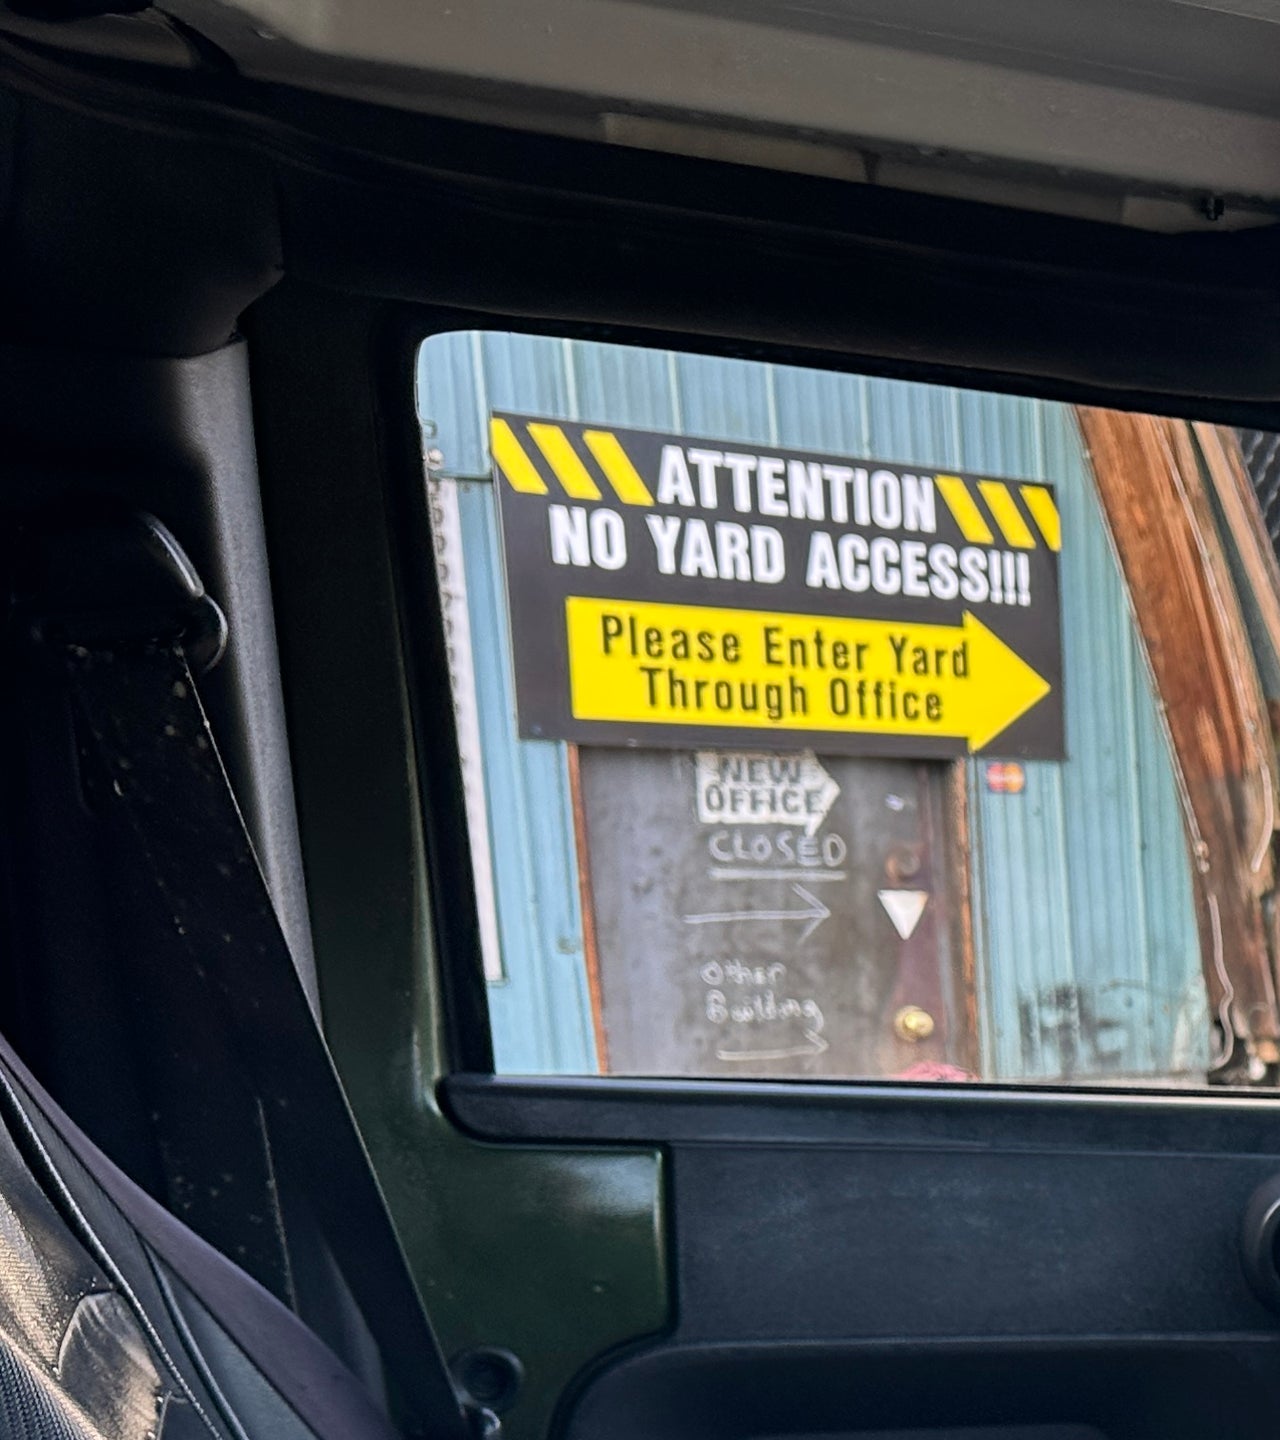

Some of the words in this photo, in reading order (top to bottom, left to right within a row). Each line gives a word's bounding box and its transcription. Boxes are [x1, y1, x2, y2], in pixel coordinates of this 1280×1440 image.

[656, 446, 938, 534] ATTENTION
[549, 503, 626, 570] NO
[645, 513, 785, 585] YARD
[806, 530, 1032, 607] ACCESS!!!
[601, 613, 742, 665] Please
[764, 627, 871, 674] Enter
[888, 635, 971, 681] Yard
[640, 666, 809, 721] Through
[829, 679, 944, 722] Office
[719, 757, 804, 784] NEW
[704, 783, 826, 815] OFFICE
[708, 830, 847, 868] CLOSED
